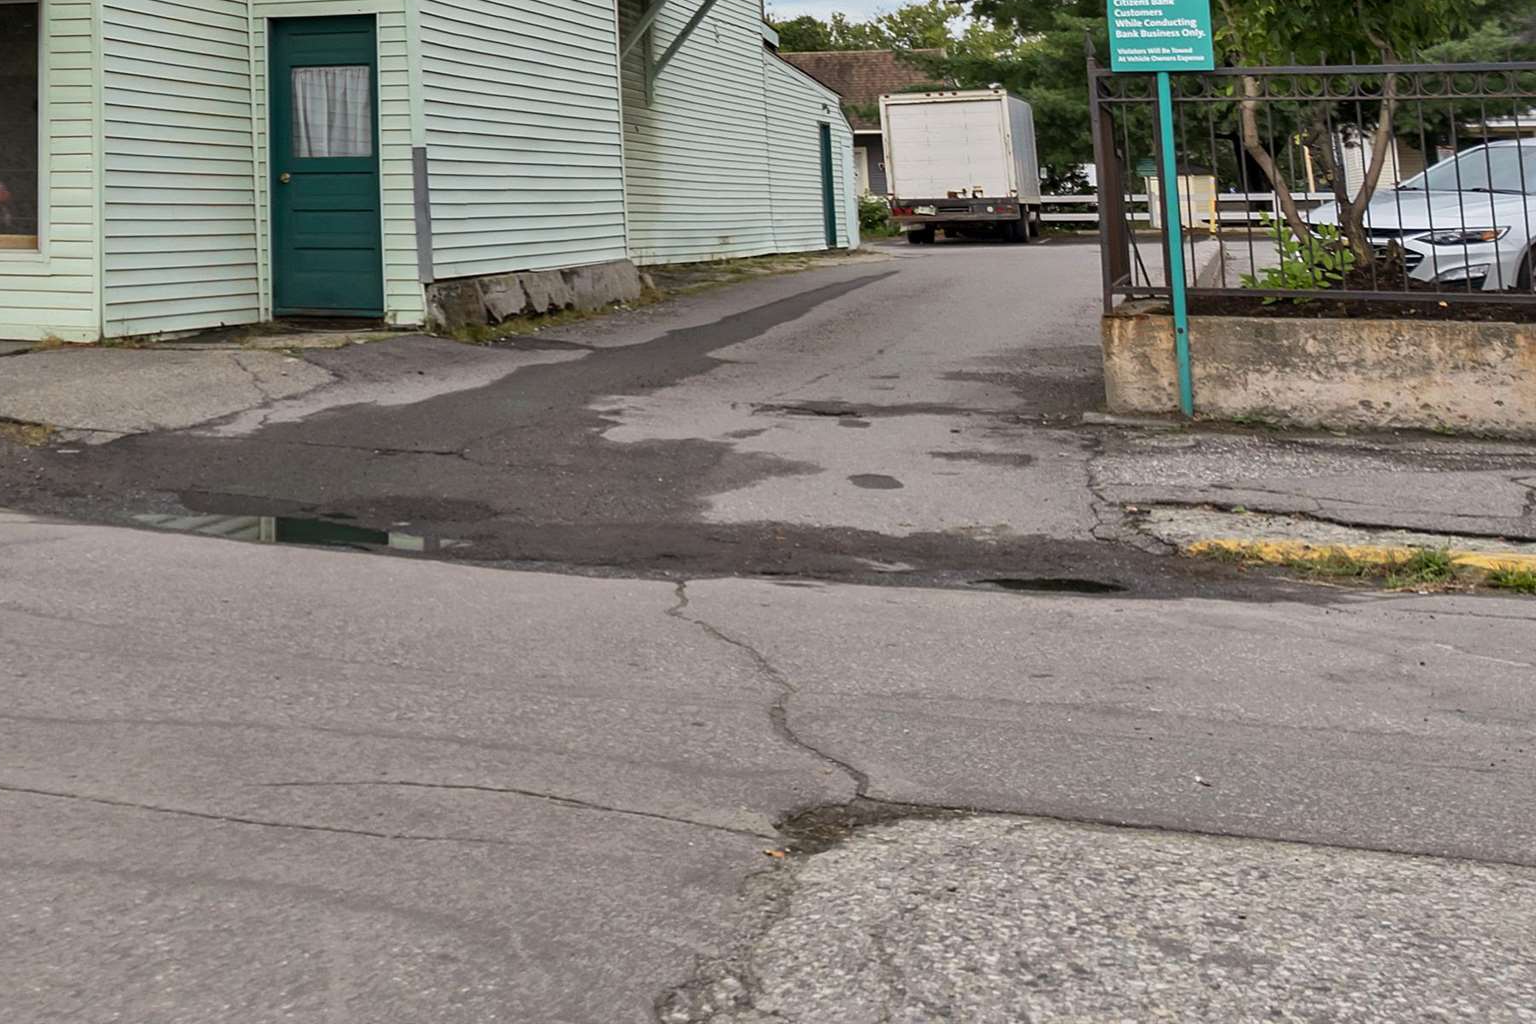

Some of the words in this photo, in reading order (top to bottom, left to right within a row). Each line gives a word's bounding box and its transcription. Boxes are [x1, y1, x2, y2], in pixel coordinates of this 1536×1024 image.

[1114, 8, 1163, 17] Customers
[1115, 18, 1143, 28] While
[1144, 17, 1198, 28] Conducting
[1116, 29, 1139, 39] Bank
[1140, 29, 1181, 38] Business
[1181, 28, 1206, 39] Only.
